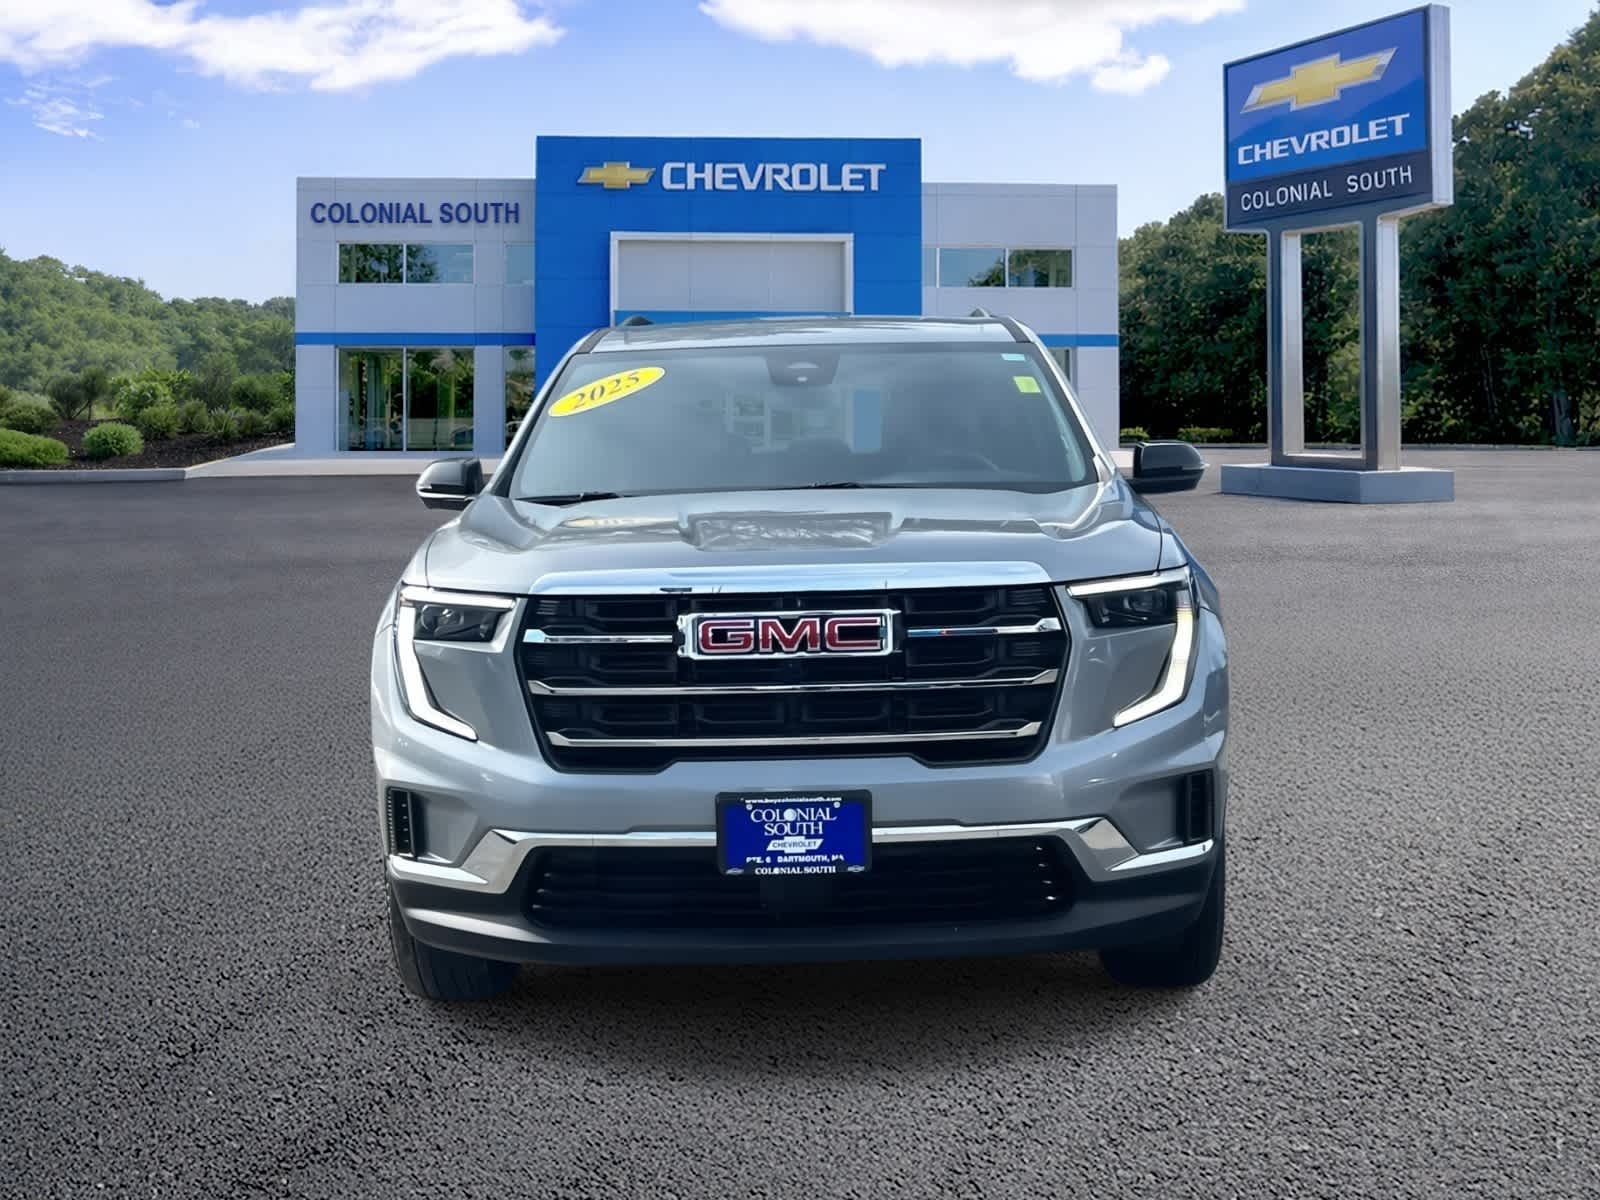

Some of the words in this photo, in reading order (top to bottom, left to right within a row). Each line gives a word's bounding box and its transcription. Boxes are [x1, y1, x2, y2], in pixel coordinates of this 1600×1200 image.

[1238, 113, 1410, 165] CHEVROLET
[661, 161, 887, 192] CHEVROLET
[1240, 180, 1333, 212] COLONIAL
[1346, 165, 1413, 193] SOUTH
[310, 202, 432, 224] COLONIAL
[439, 202, 520, 224] SOUTH
[571, 371, 640, 410] 2025
[698, 616, 881, 654] GMC
[750, 807, 837, 823] COLONIAL
[764, 821, 824, 837] SOUTH
[772, 840, 817, 849] CHEVROLET
[754, 866, 803, 875] COLONIAL
[803, 865, 836, 874] SOUTH
